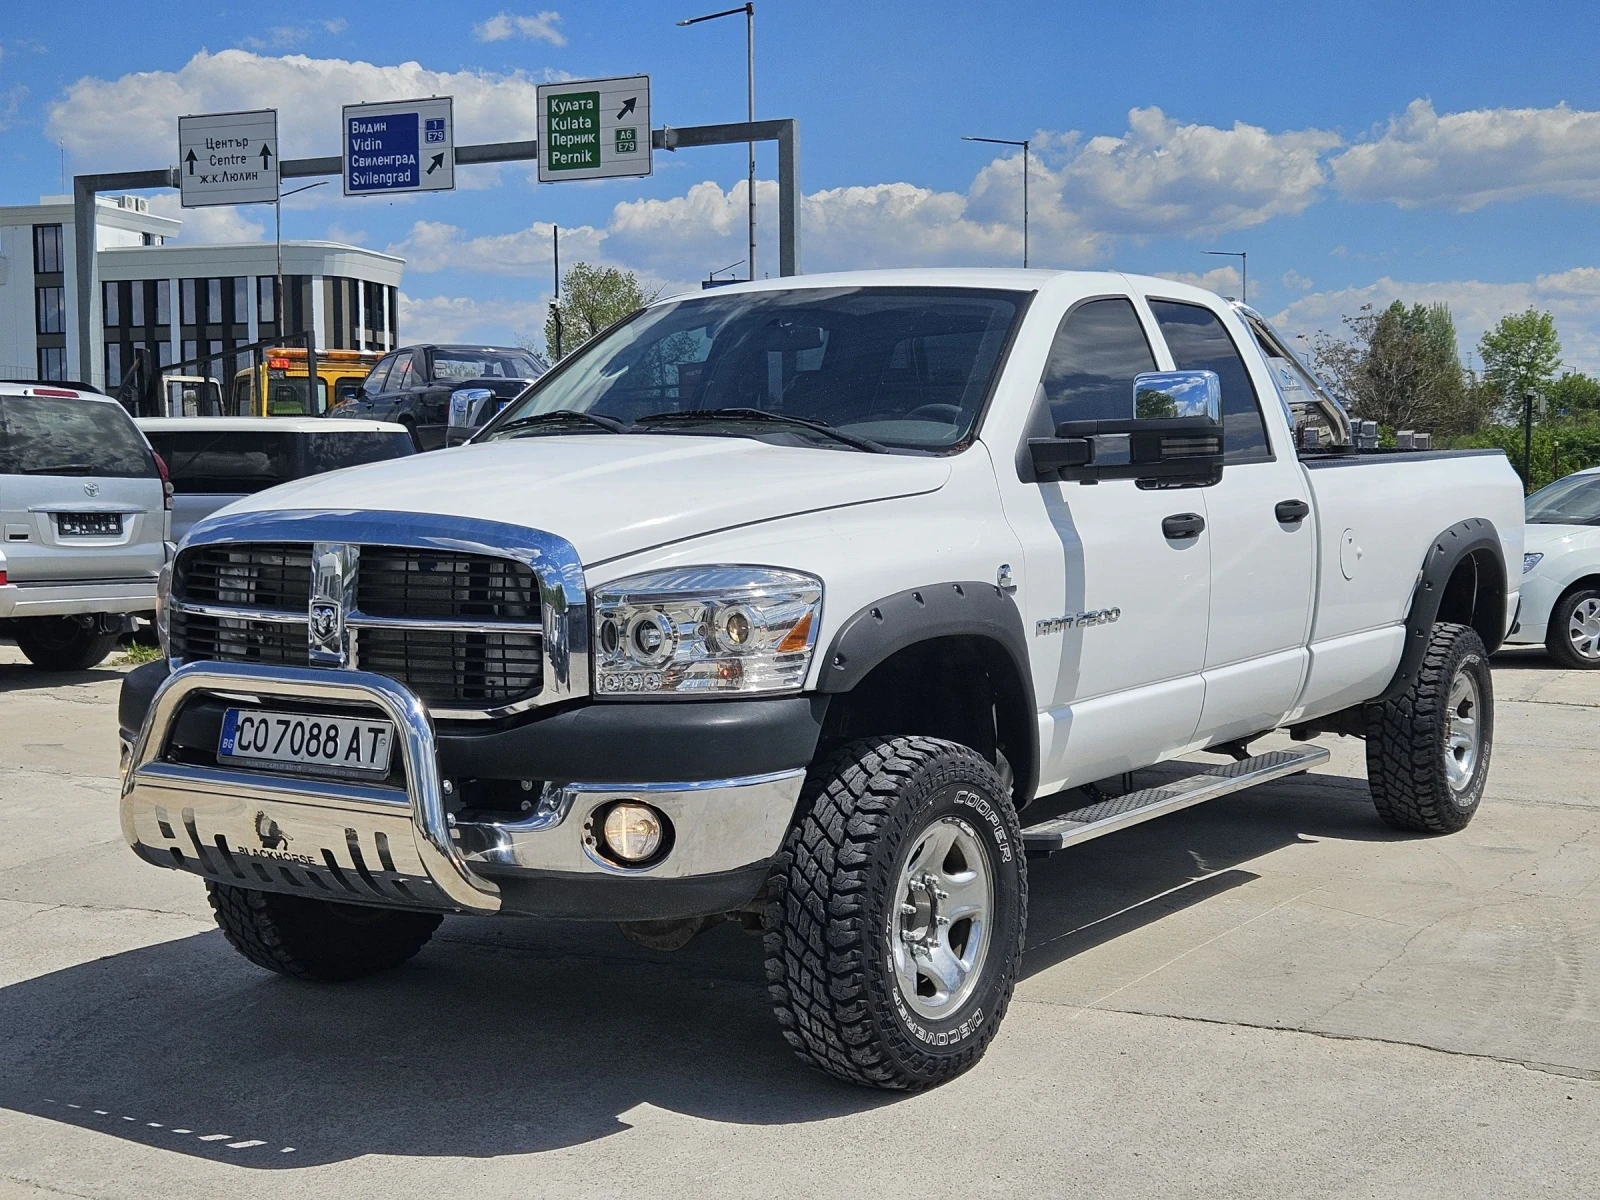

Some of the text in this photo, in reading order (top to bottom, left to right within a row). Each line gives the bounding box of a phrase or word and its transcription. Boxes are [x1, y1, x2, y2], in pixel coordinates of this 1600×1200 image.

[551, 99, 594, 114] Кулата
[352, 121, 387, 133] Видин
[551, 116, 592, 131] Kulata
[428, 131, 444, 141] E79
[551, 133, 595, 147] Перник
[620, 130, 632, 140] A6
[206, 137, 249, 151] Център
[352, 138, 382, 151] Vidin
[618, 142, 635, 152] E79
[209, 154, 247, 166] Centre
[352, 154, 416, 167] Свиленград
[552, 150, 592, 164] Pernik
[352, 169, 411, 186] Svilengrad
[222, 738, 234, 749] BG
[953, 790, 1012, 863] COOPER
[237, 846, 317, 866] BLACKHORSE
[892, 986, 985, 1046] DISCOVERER
